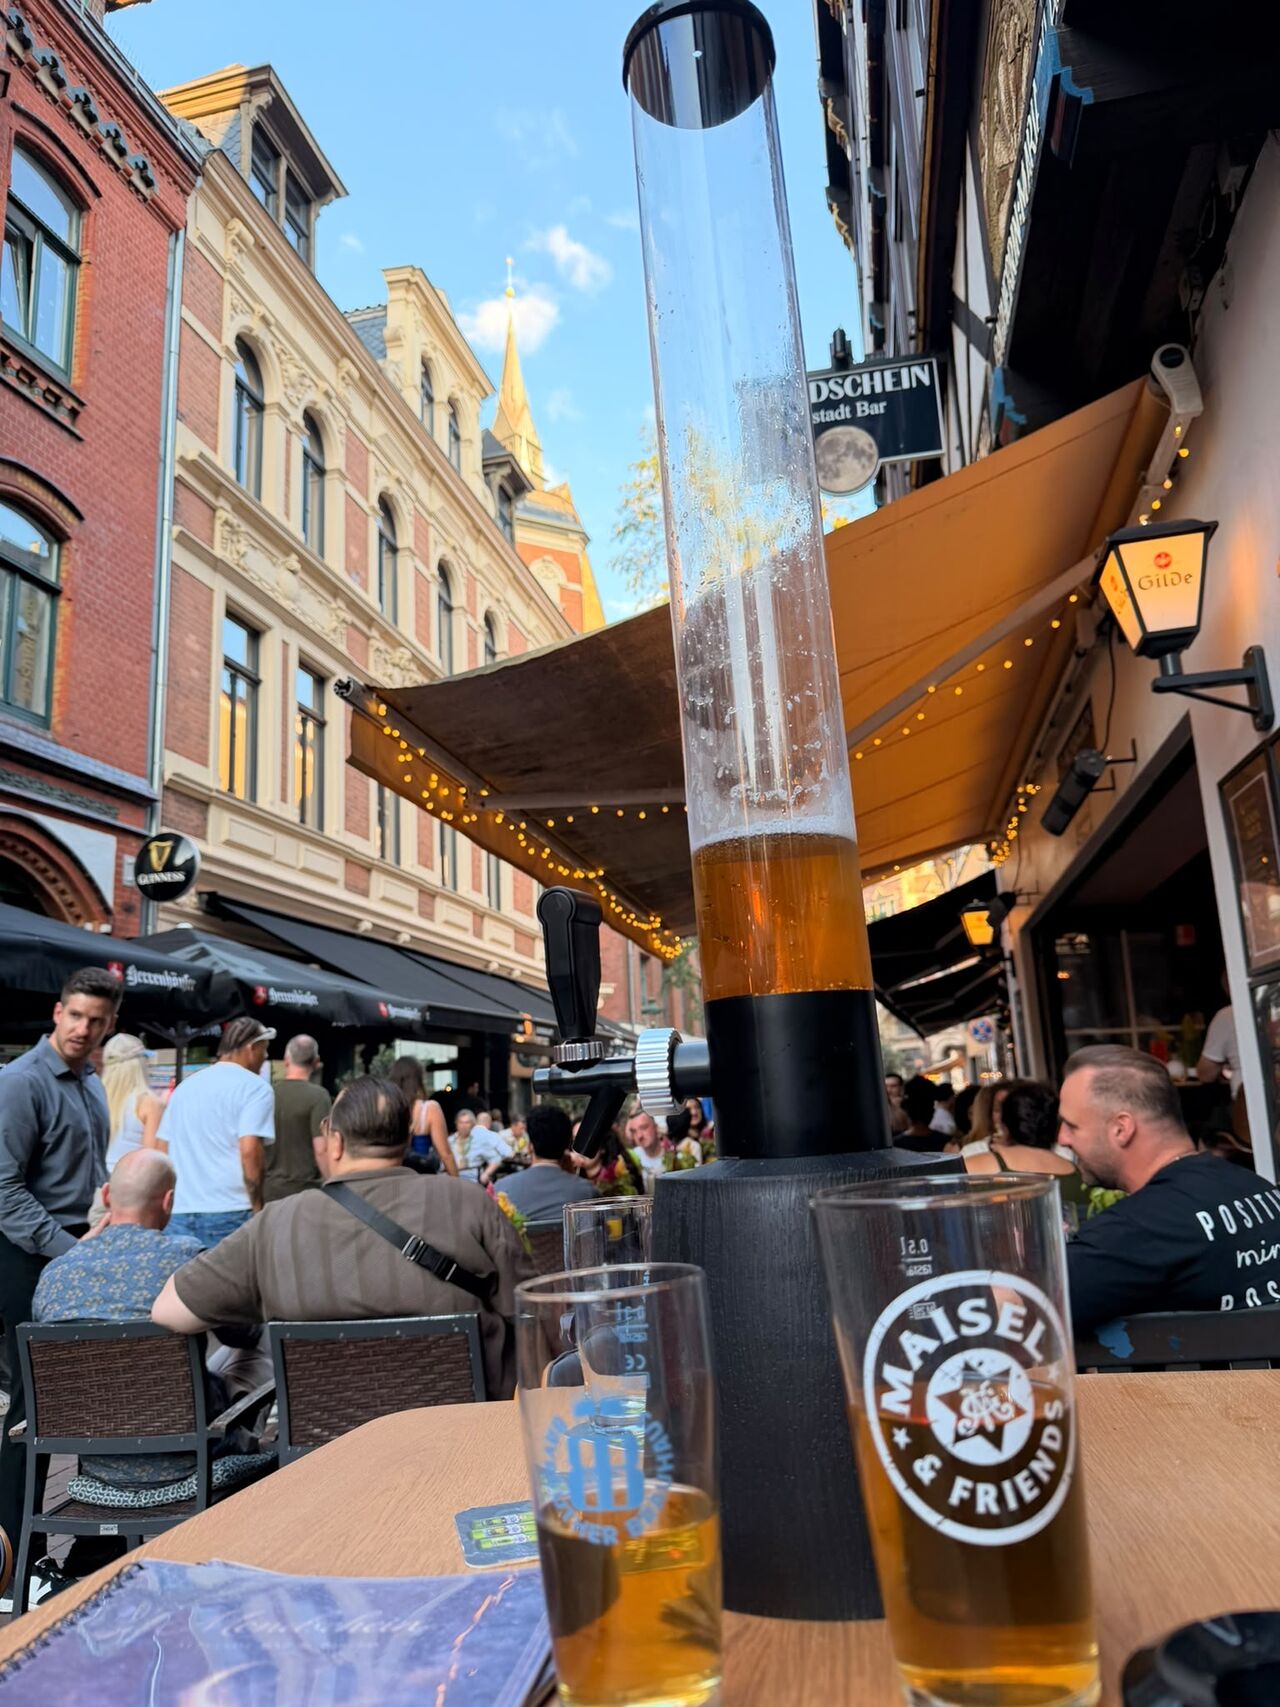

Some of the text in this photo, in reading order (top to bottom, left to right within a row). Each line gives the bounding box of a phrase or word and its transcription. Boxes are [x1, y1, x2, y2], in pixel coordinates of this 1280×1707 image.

[808, 364, 931, 404] DSCHEIN
[811, 400, 887, 424] stadt Bar
[1138, 571, 1193, 590] Gilde
[880, 1298, 1047, 1417] MAISEL
[912, 1399, 1064, 1515] & FRIENDS
